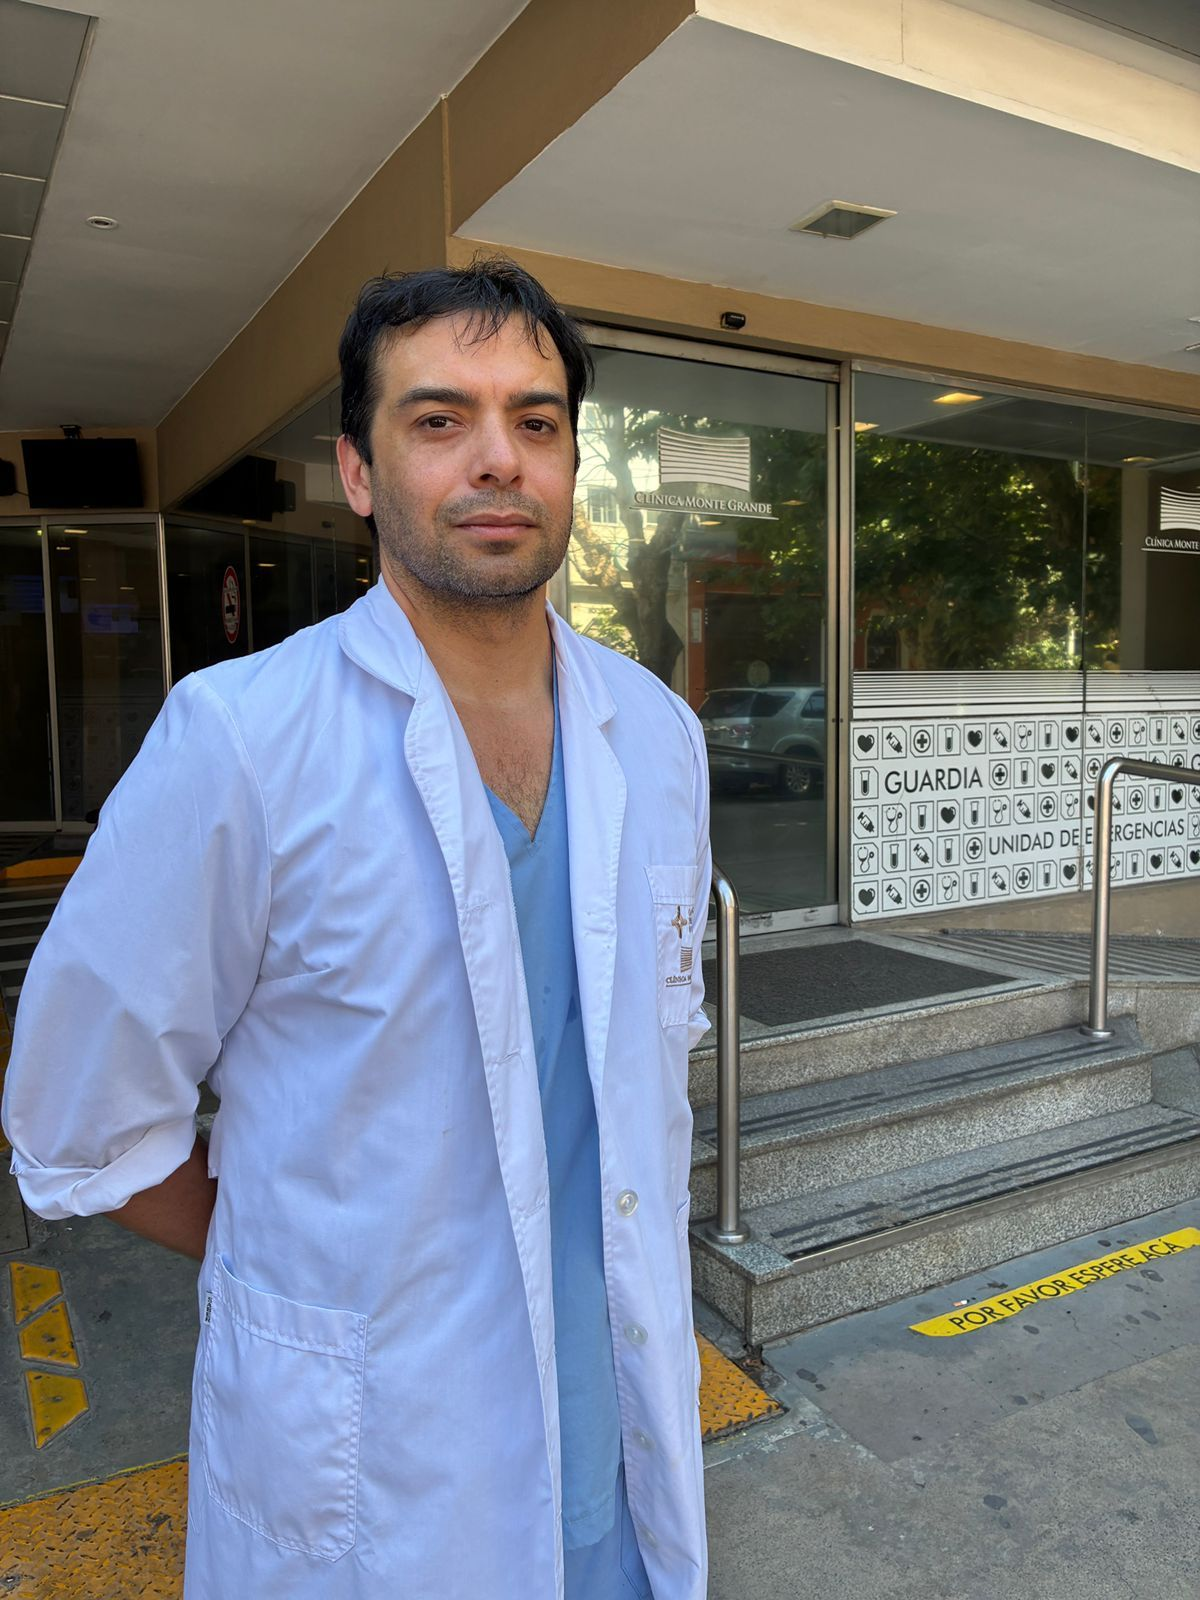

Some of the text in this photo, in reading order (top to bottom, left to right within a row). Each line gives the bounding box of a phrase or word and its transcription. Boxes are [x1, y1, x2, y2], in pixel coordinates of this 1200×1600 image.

[685, 496, 726, 510] MONTE
[728, 499, 772, 514] GRANDE
[1174, 538, 1200, 550] MONTE
[884, 767, 984, 795] GUARDIA
[989, 818, 1185, 856] UNIDAD DE ERGENCIAS
[949, 1238, 1186, 1331] POR FAVOR ESPERE ACÁ
